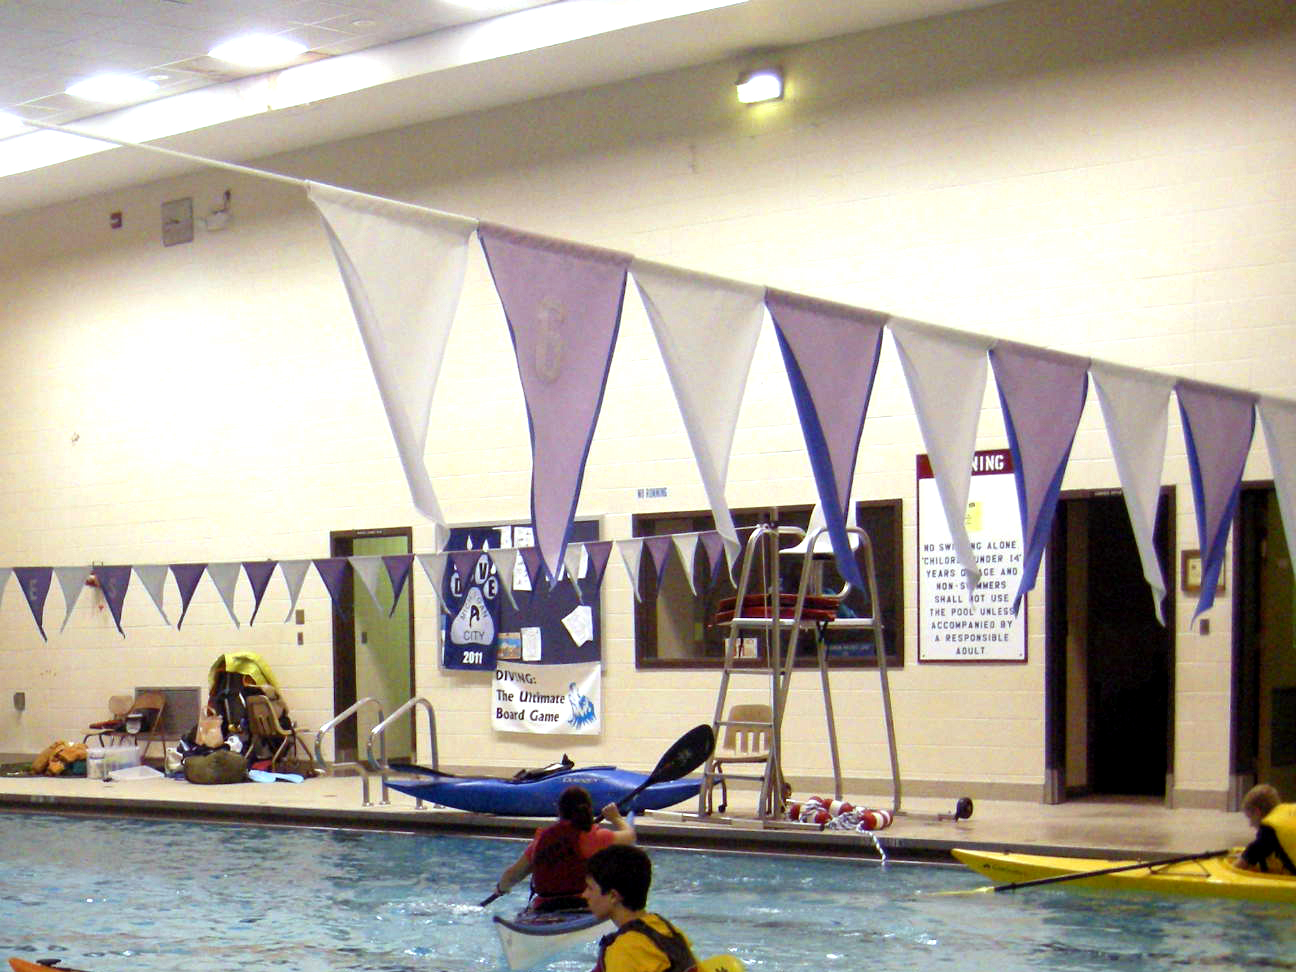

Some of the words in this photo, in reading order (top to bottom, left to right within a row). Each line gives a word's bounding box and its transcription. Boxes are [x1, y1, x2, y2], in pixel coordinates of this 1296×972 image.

[972, 455, 1004, 471] NING
[924, 544, 935, 552] NO
[939, 542, 982, 551] SWING
[987, 541, 1017, 550] ALONE
[926, 569, 956, 578] YEARS
[1001, 567, 1018, 575] AND
[934, 595, 963, 603] SHALL
[991, 594, 1009, 602] USE
[930, 608, 946, 616] THE
[951, 608, 974, 616] POOL
[931, 620, 995, 629] ACCOMPANIED
[1000, 620, 1013, 629] BY
[464, 630, 485, 641] CITY
[945, 633, 1009, 642] RESPONSIBLE
[956, 646, 985, 655] ADULT
[462, 651, 483, 664] 2011
[496, 689, 514, 702] The
[519, 690, 565, 704] Ultimate
[496, 707, 525, 720] Board
[529, 709, 560, 722] Game
